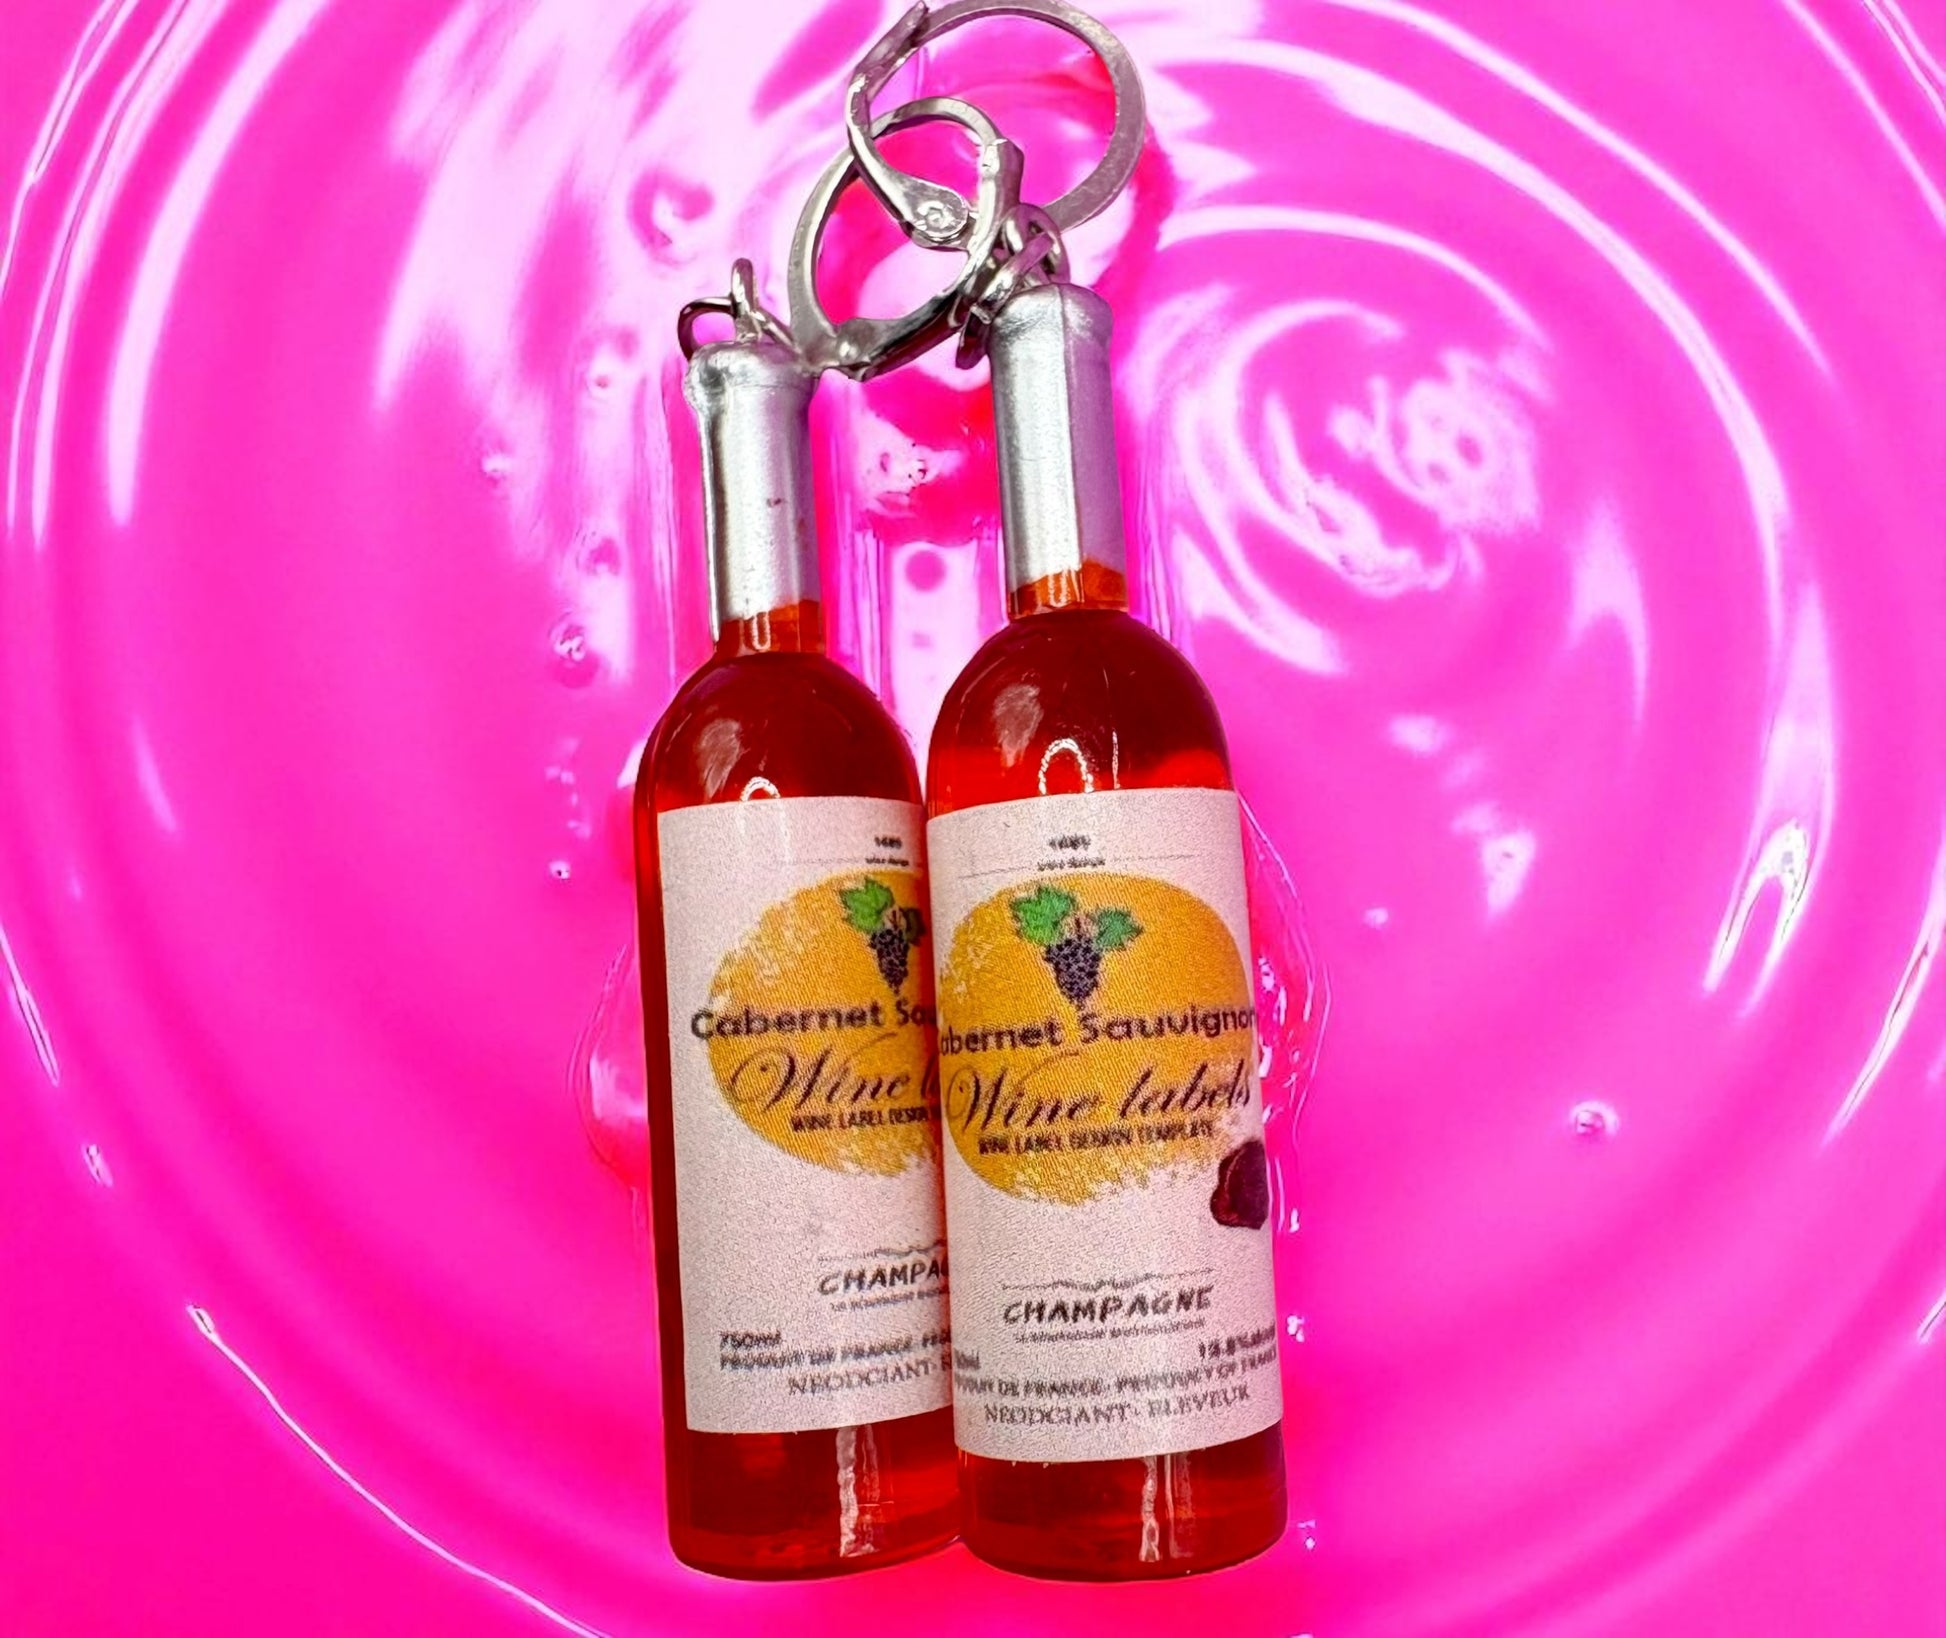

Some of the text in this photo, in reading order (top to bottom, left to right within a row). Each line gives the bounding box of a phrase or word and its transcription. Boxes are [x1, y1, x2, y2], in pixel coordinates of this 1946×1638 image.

[690, 1002, 883, 1040] Cabernet
[728, 1034, 911, 1114] Wine
[948, 1050, 1251, 1133] Wine labels
[838, 1109, 883, 1130] LABEL
[1014, 1131, 1062, 1153] LABEL
[1068, 1126, 1134, 1149] DESIGN
[1002, 1285, 1215, 1325] CHAMPAGNE
